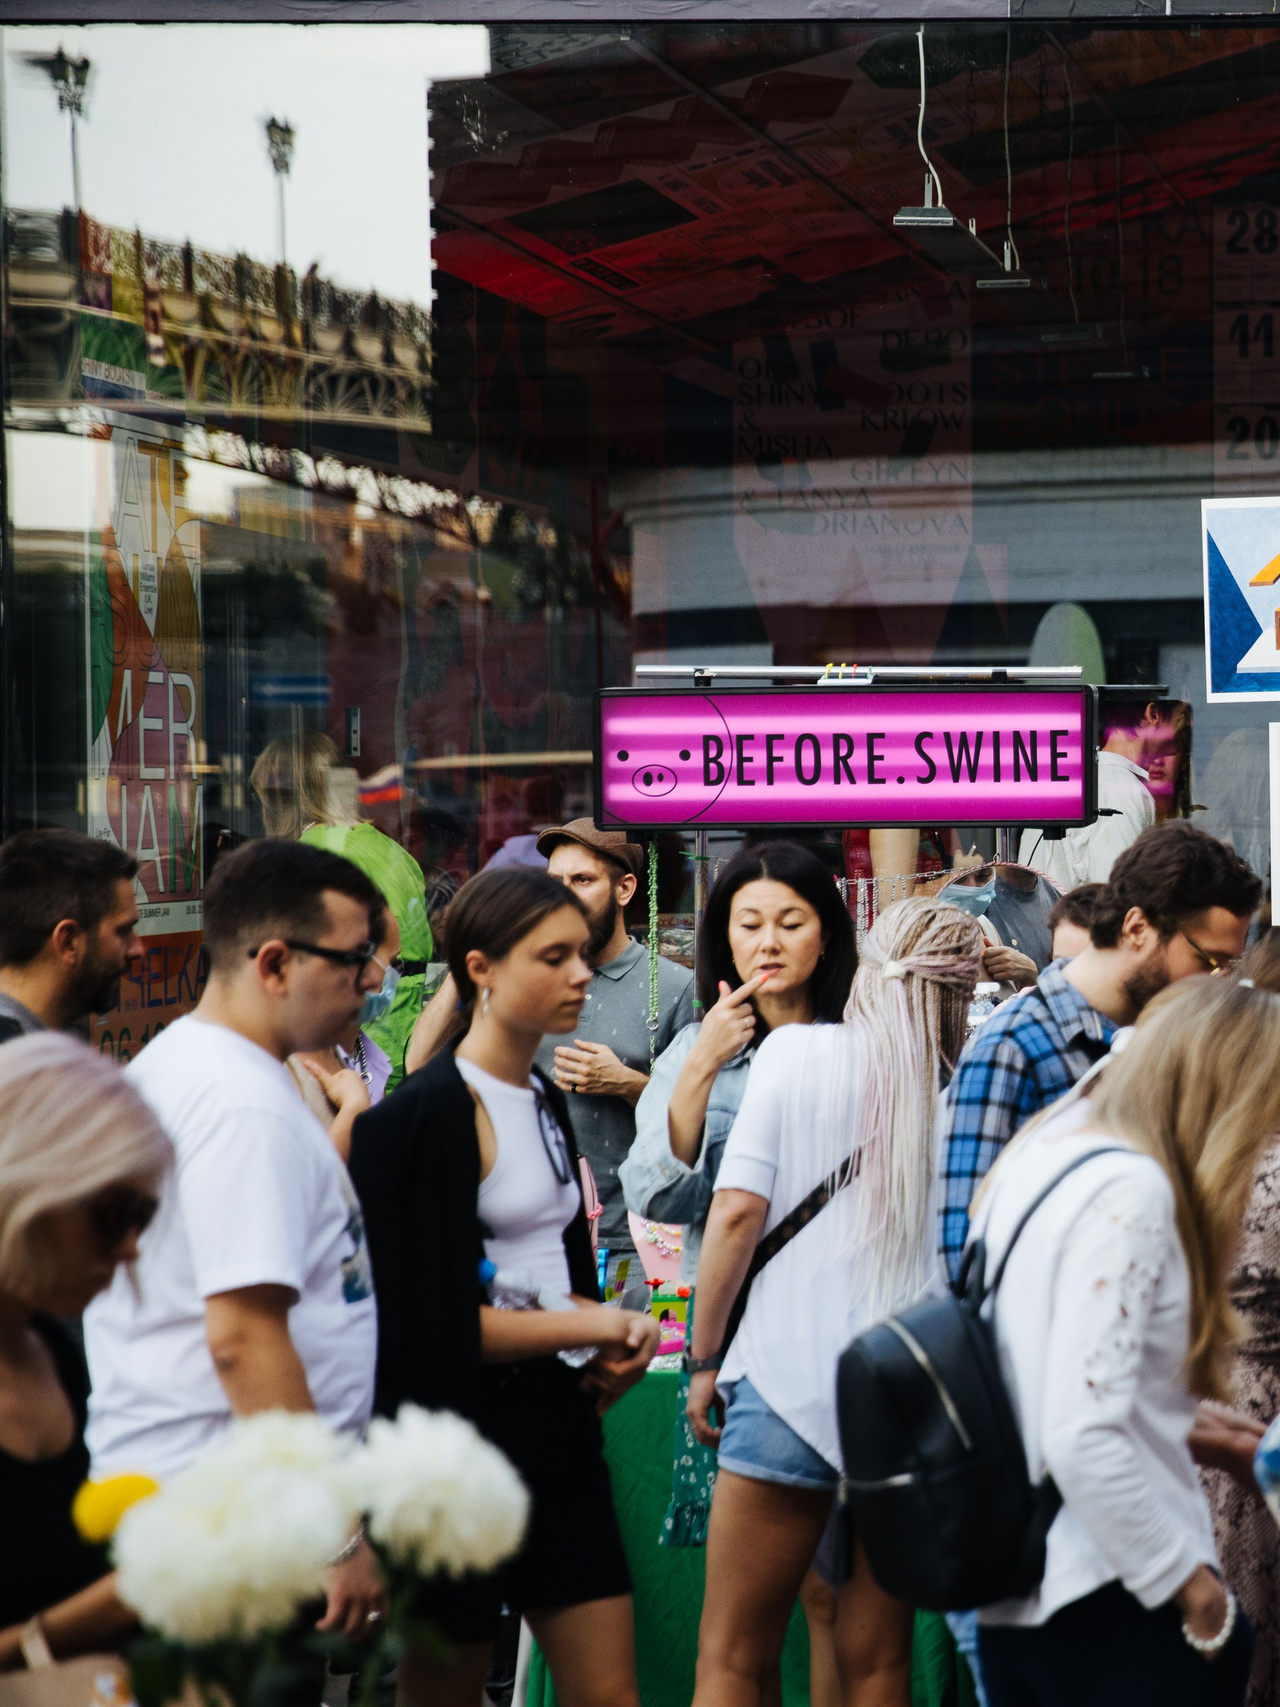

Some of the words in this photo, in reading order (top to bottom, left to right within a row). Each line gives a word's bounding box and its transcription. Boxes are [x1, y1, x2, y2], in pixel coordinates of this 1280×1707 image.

[1225, 208, 1279, 255] 28
[1229, 312, 1274, 357] 11
[738, 435, 833, 458] MISHA
[1226, 415, 1280, 461] 20
[701, 729, 1071, 787] BEFORE.SWINE
